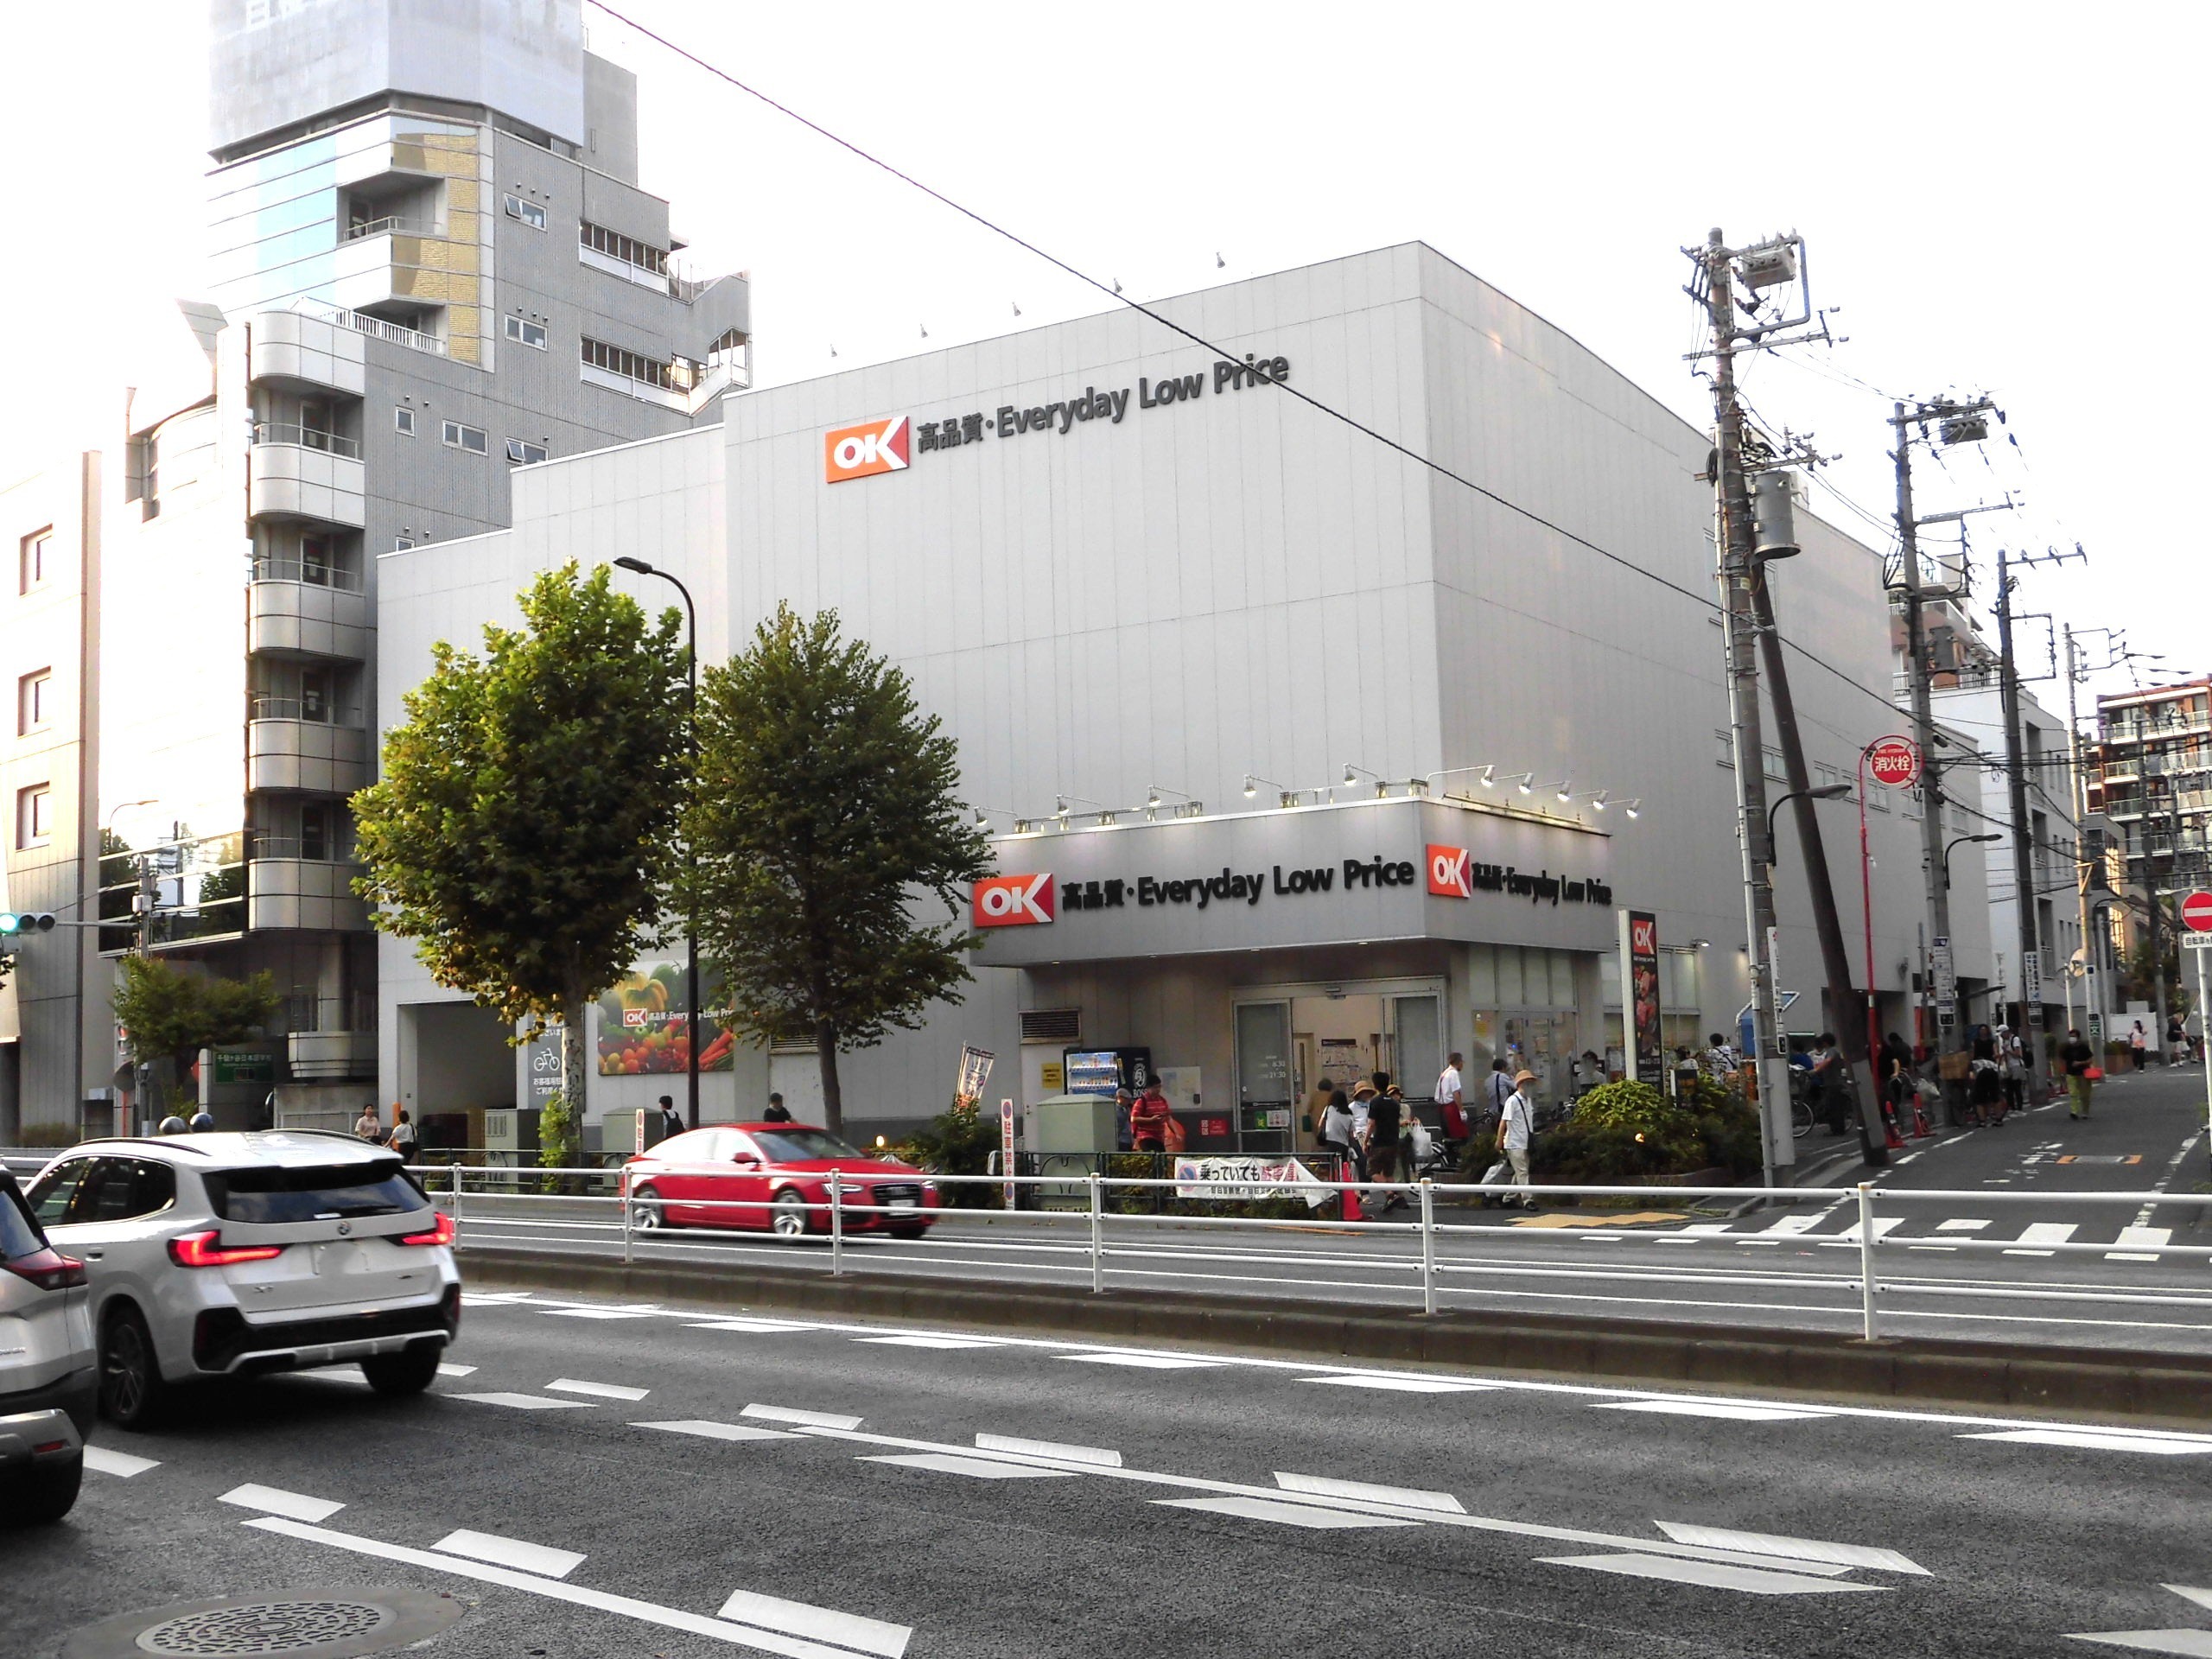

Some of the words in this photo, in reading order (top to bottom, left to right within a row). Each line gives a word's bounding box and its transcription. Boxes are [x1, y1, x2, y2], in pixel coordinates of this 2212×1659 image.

[997, 387, 1129, 438] Everyday
[1139, 371, 1203, 409] Low
[1213, 353, 1289, 395] Price
[833, 416, 910, 470] OK
[1874, 755, 1910, 772] 消火栓
[1138, 868, 1264, 908] Everyday
[1273, 865, 1334, 895] Low
[1343, 855, 1414, 890] Price
[1433, 849, 1471, 898] OK
[982, 874, 1053, 923] OK
[1635, 922, 1654, 954] OK
[626, 1009, 645, 1026] OK
[703, 1009, 719, 1019] Low
